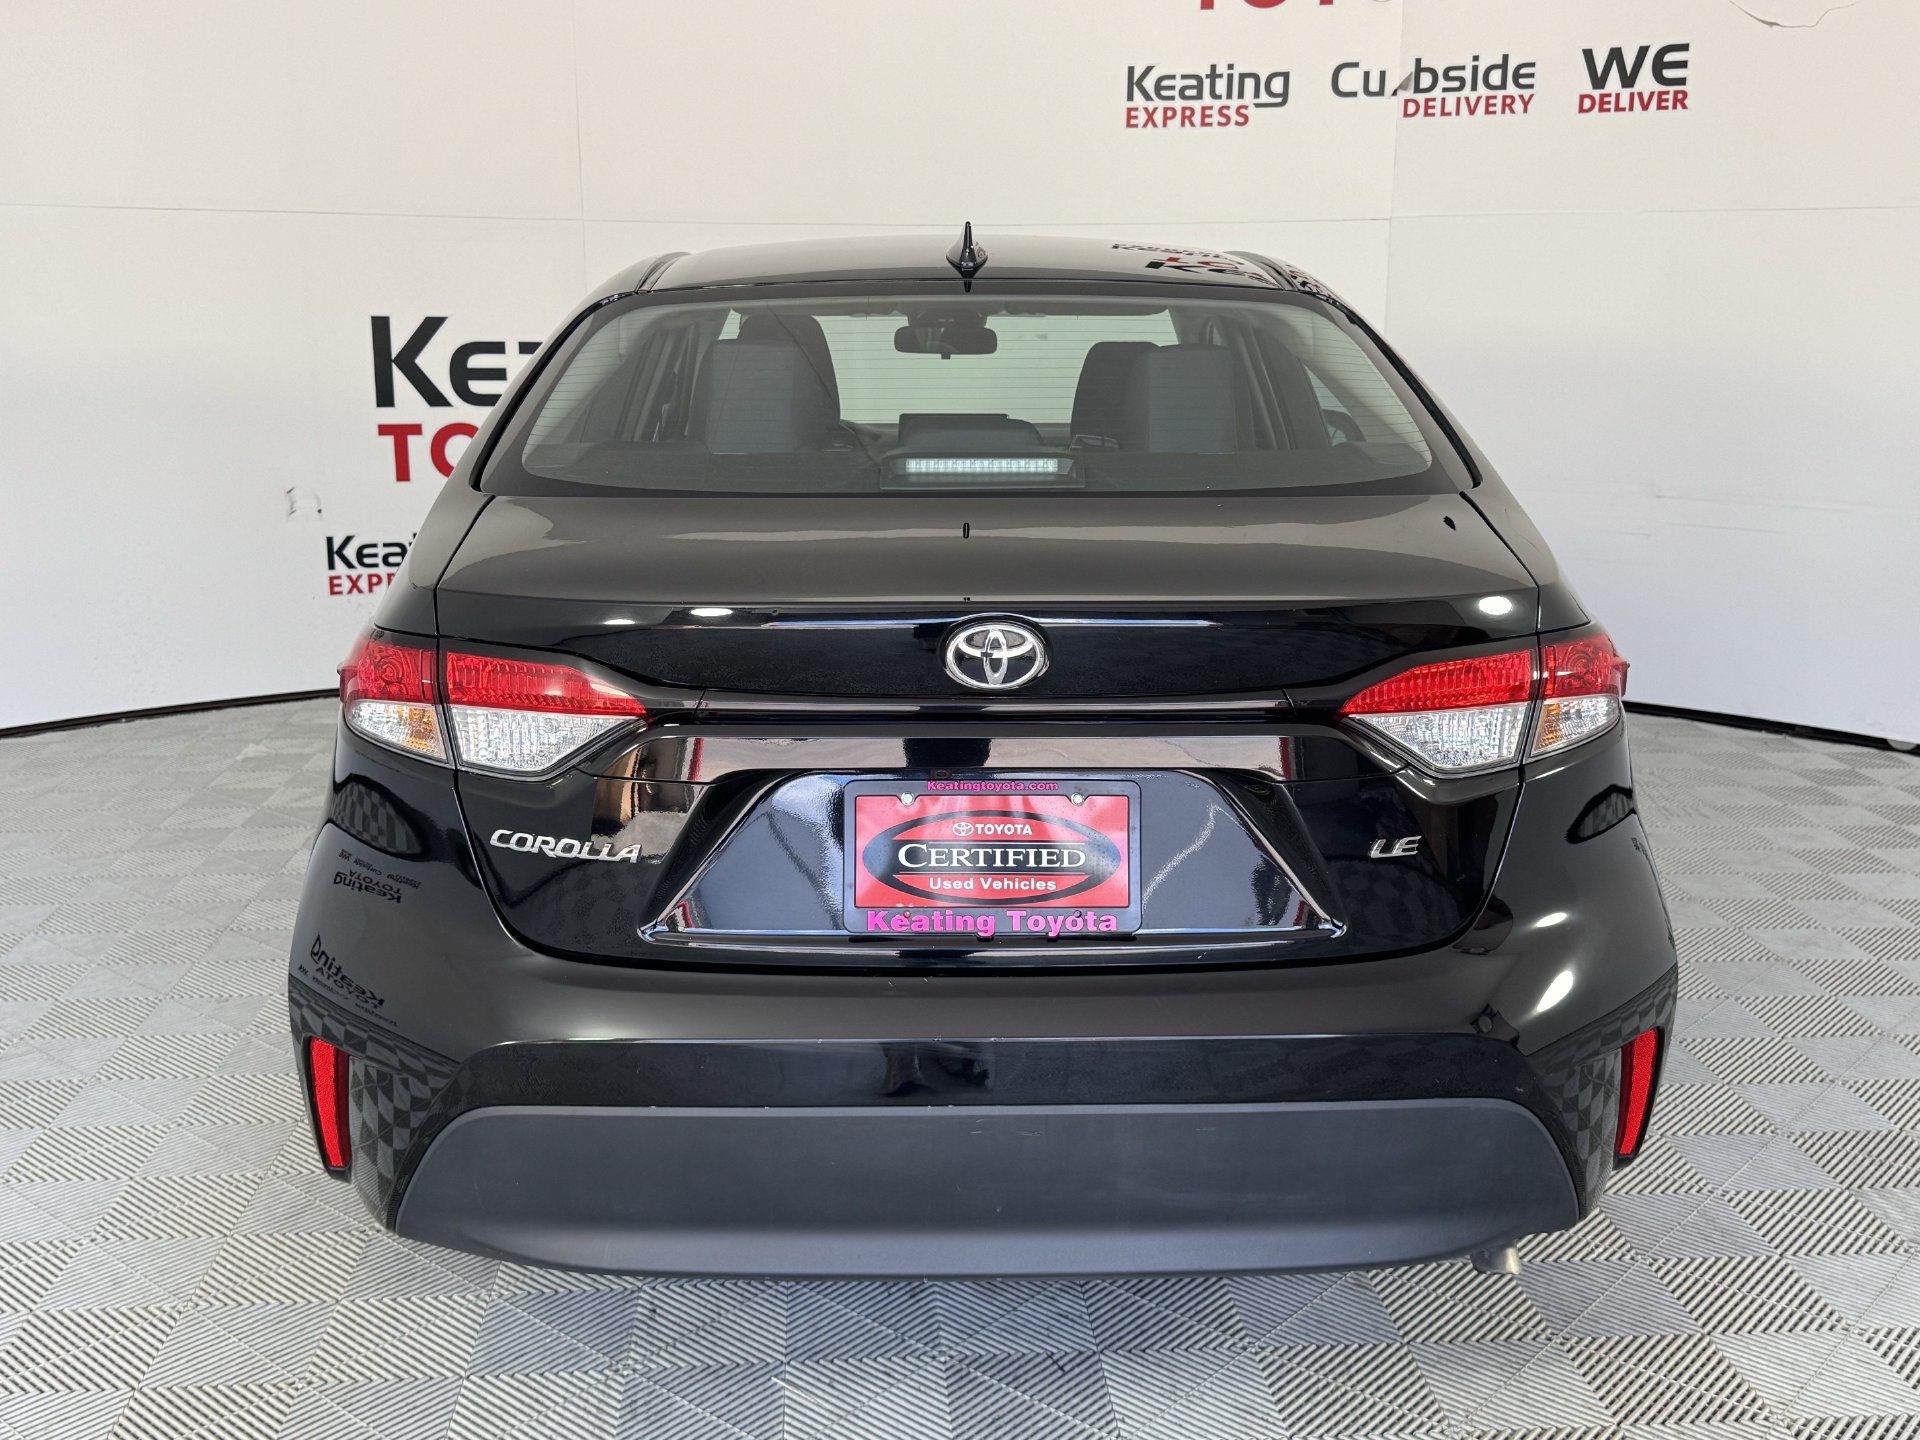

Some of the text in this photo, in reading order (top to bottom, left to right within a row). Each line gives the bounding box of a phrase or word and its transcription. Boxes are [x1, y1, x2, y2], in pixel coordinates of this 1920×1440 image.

[1331, 53, 1536, 98] Cubside
[1581, 42, 1690, 90] WE
[1126, 63, 1290, 108] Keating
[1403, 94, 1535, 118] DELIVERY
[1578, 90, 1689, 114] DELIVER
[1126, 105, 1249, 128] EXPRESS
[326, 532, 418, 570] Kea
[926, 780, 1059, 792] Keatingtoyota.com
[975, 823, 1032, 836] TOYOTA
[490, 829, 642, 864] COROLLA
[898, 843, 1087, 869] CERTIFIED
[1368, 835, 1422, 859] LE
[333, 871, 402, 904] Keating
[929, 877, 1057, 891] Used Vehicles
[867, 910, 1118, 937] Keating Toyota
